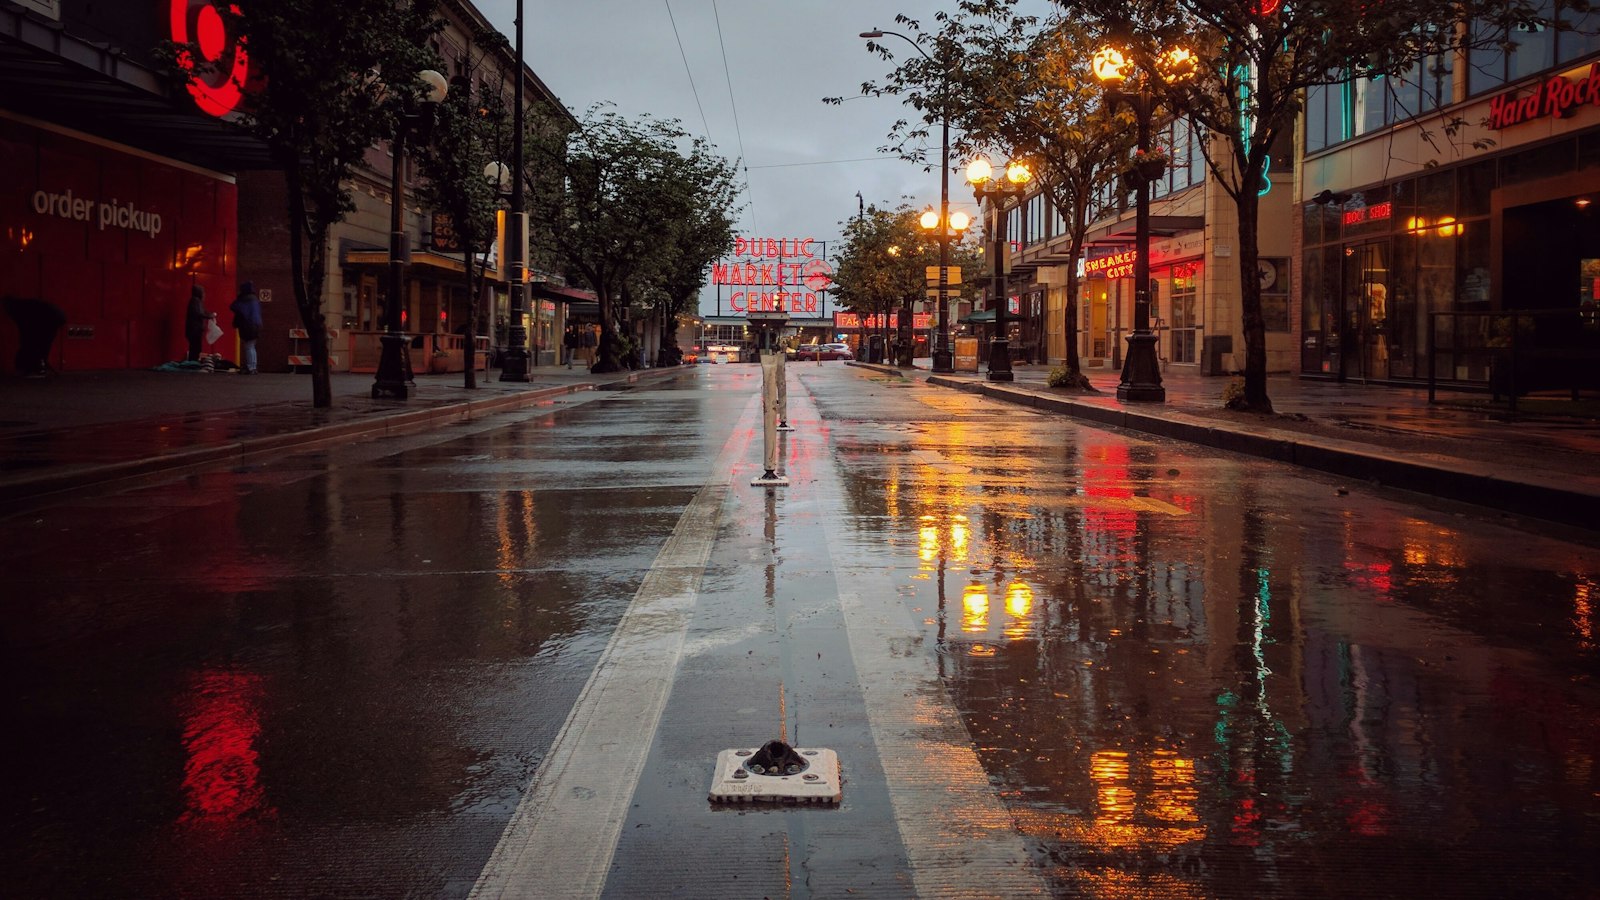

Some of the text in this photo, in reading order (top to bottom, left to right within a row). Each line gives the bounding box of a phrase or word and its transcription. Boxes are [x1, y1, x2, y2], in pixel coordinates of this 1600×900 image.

[1488, 62, 1600, 130] Hard Rock
[33, 188, 162, 239] order pickup
[735, 237, 814, 258] PUBLIC
[712, 263, 801, 286] MARKET
[1106, 263, 1134, 279] CITY
[730, 292, 817, 313] CENTER
